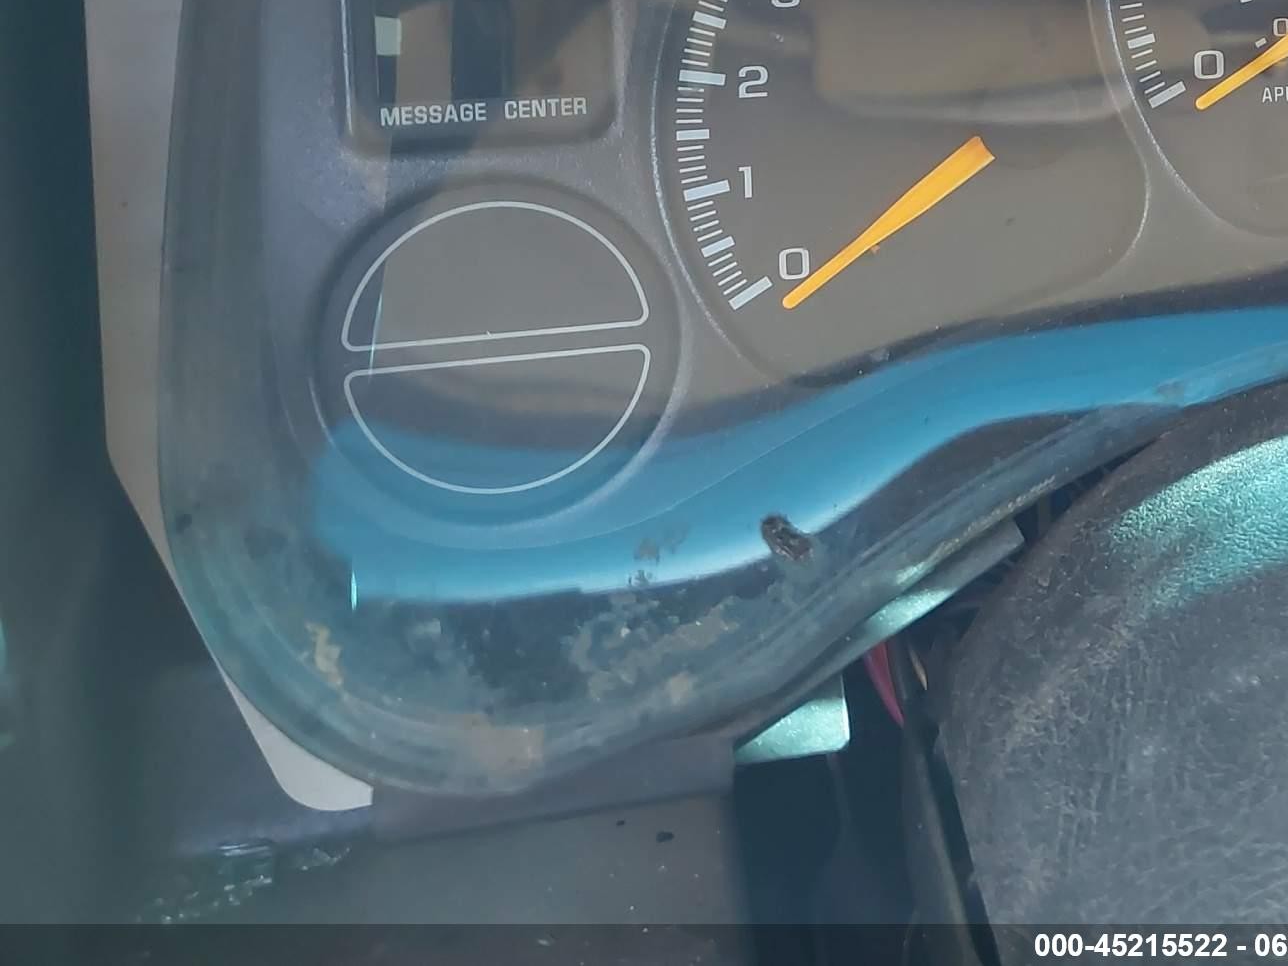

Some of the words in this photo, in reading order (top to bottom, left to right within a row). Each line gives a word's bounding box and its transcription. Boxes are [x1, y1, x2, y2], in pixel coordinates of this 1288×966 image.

[1193, 49, 1225, 80] 0
[738, 66, 768, 98] 2
[380, 102, 487, 126] MESSAGE
[504, 97, 587, 120] CENTER
[739, 166, 754, 198] 1
[779, 247, 810, 280] 0
